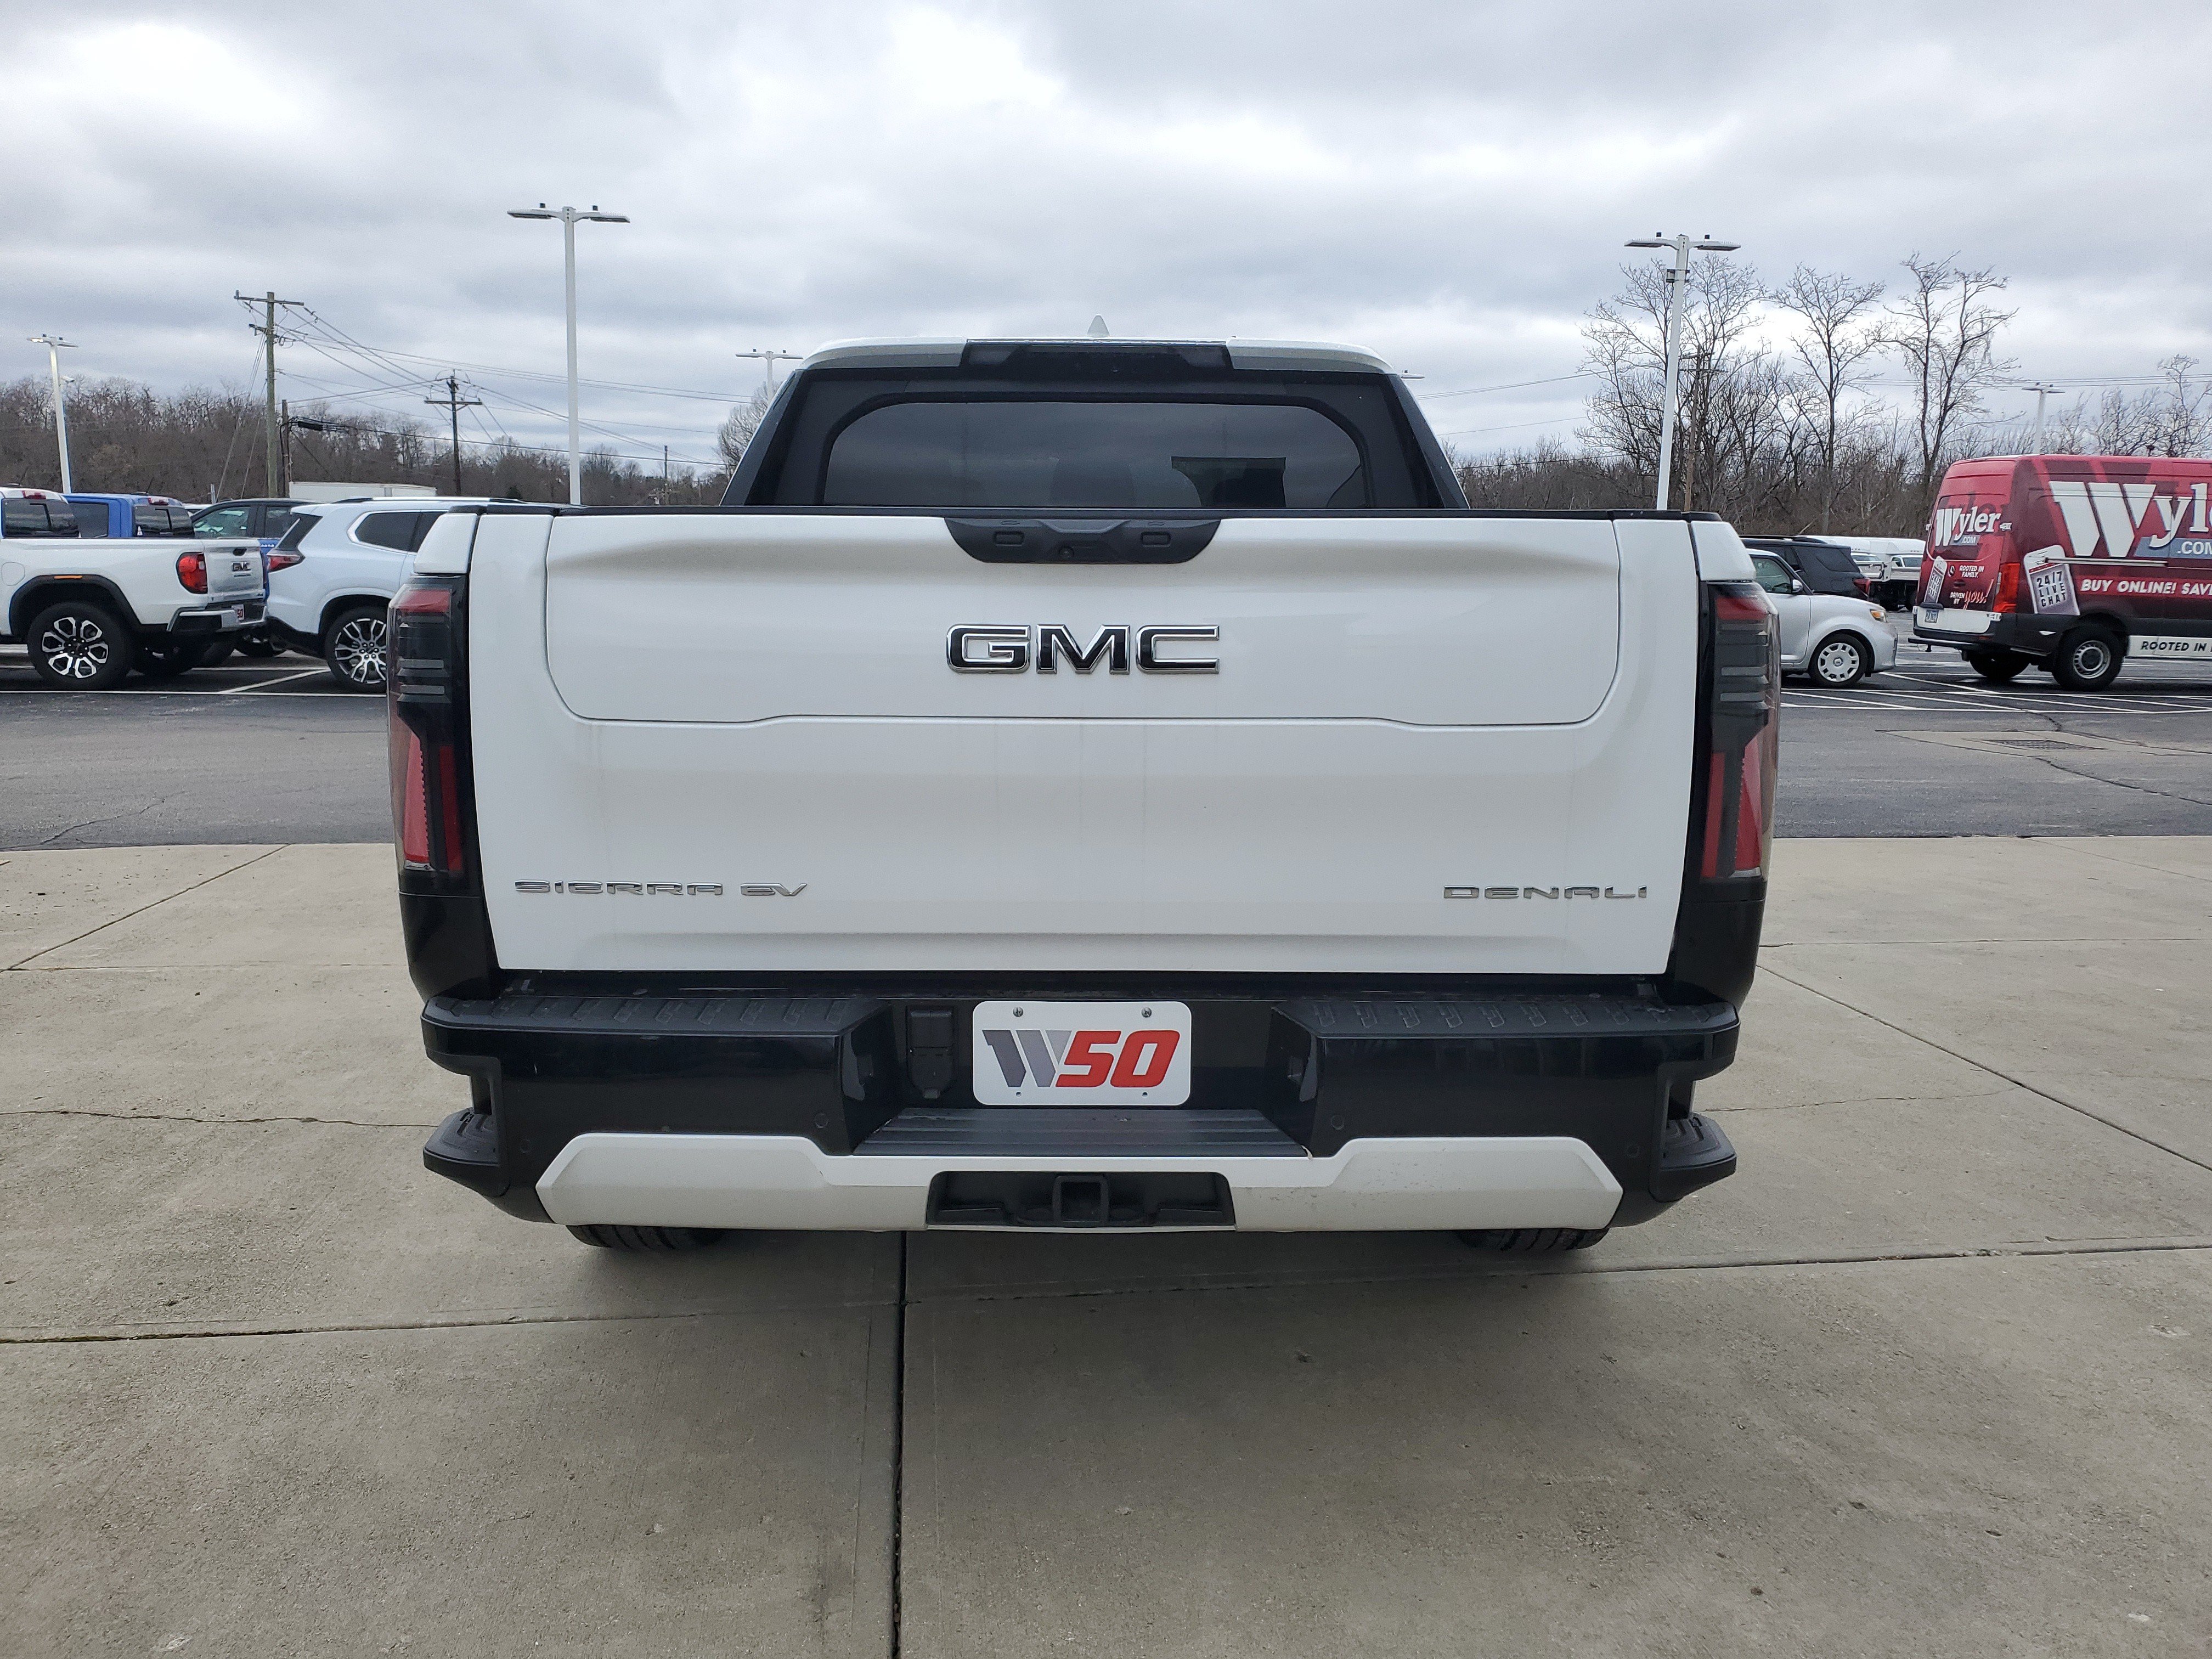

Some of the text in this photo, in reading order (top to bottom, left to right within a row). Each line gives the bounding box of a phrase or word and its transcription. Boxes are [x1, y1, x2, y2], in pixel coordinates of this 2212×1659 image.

[1935, 506, 2001, 546] Wyler
[2048, 481, 2212, 557] Wyl
[232, 562, 252, 572] GMC
[2036, 571, 2062, 588] 24/7
[2080, 579, 2113, 592] BUY
[2117, 580, 2177, 594] ONLINE!
[2039, 583, 2066, 597] LIVE
[2041, 592, 2066, 607] CHAT
[946, 623, 1220, 675] GMC
[2140, 641, 2190, 651] ROOTED
[2193, 642, 2207, 652] IN
[515, 879, 808, 897] SIERRA EV
[1443, 885, 1647, 899] DENALI
[981, 1029, 1181, 1088] W50
